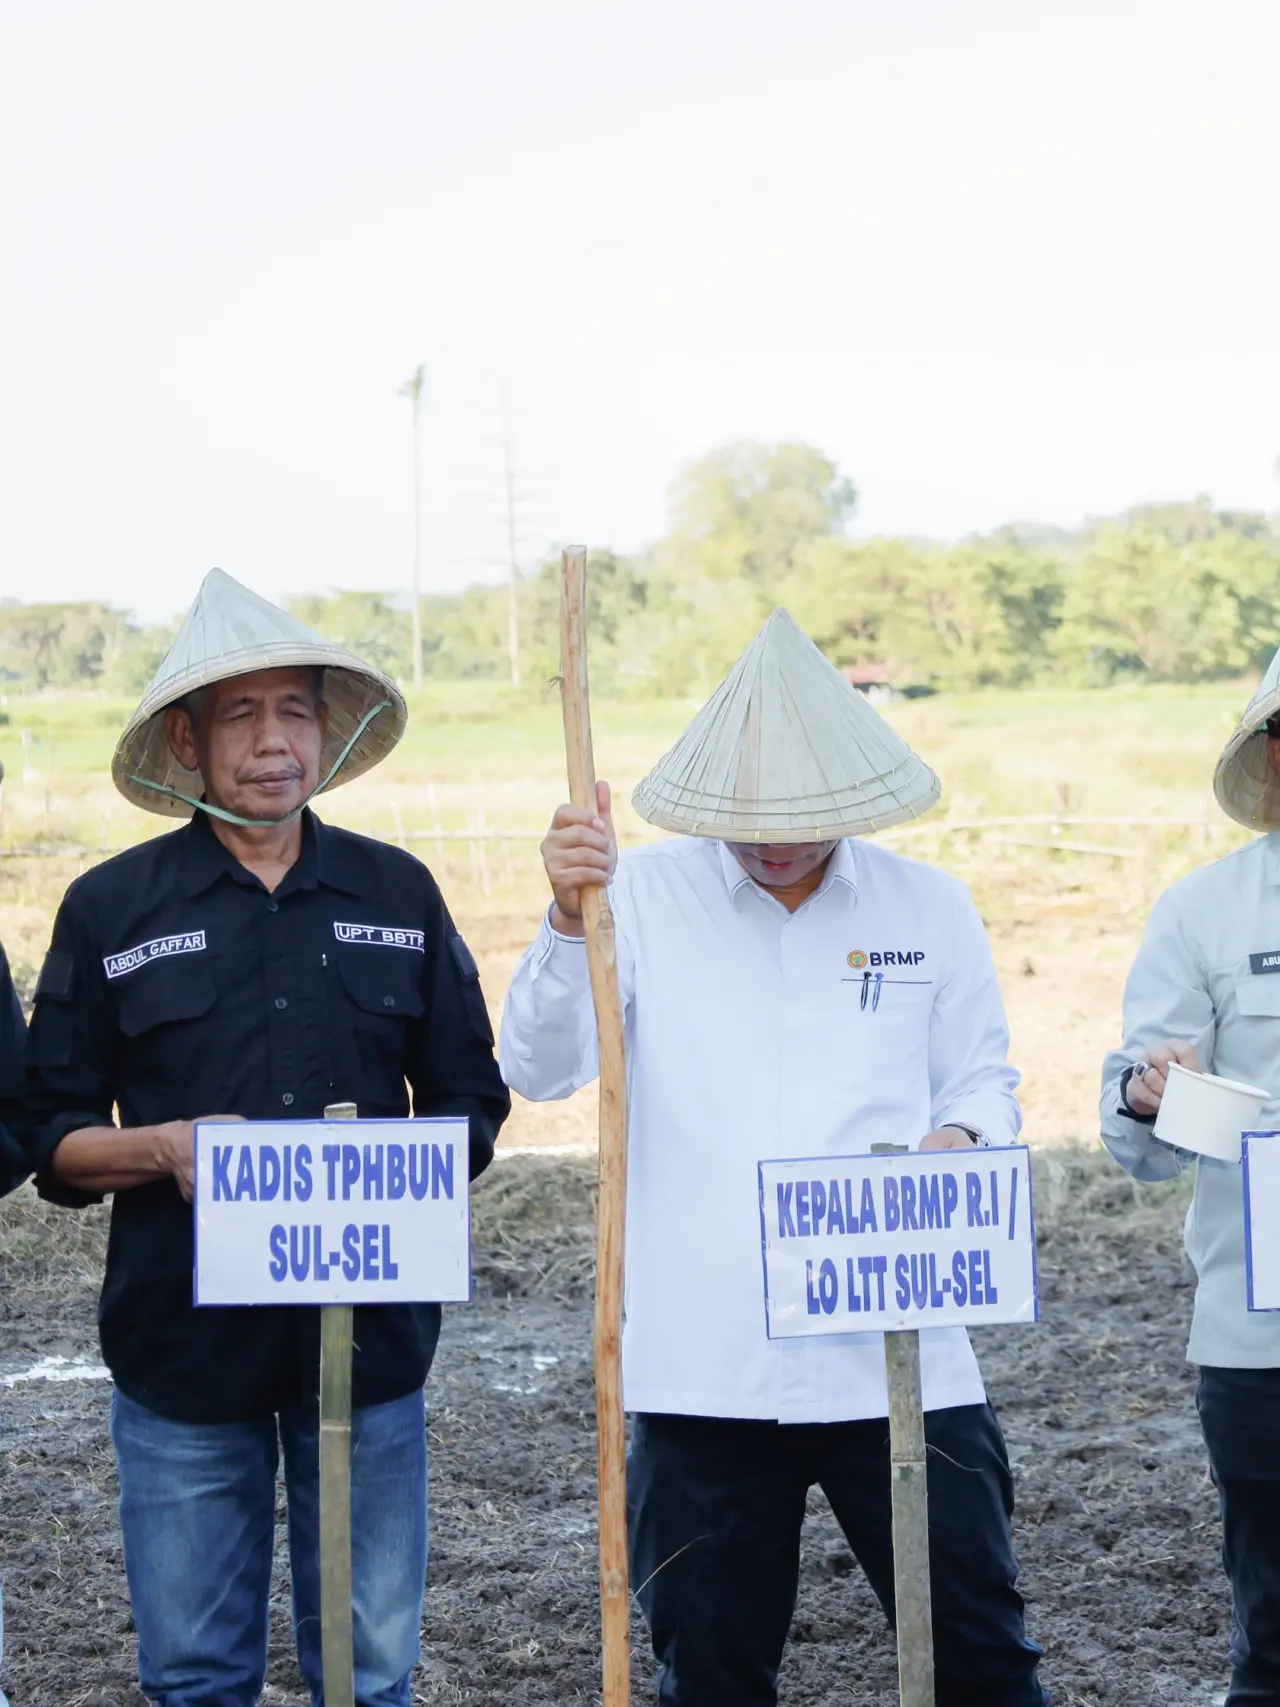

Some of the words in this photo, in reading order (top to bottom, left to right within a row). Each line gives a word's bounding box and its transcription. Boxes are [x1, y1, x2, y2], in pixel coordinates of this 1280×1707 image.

[110, 949, 148, 974] ABDUL
[149, 935, 202, 956] GAFFAR
[338, 926, 375, 941] UPT
[869, 950, 926, 967] BRMP
[212, 1143, 314, 1202] KADIS
[322, 1143, 454, 1201] TPHBUN
[776, 1177, 878, 1238] KEPALA
[883, 1172, 959, 1232] BRMP
[269, 1223, 399, 1283] SUL-SEL
[805, 1257, 839, 1316] LO
[847, 1254, 888, 1313] LTT
[894, 1249, 998, 1311] SUL-SEL
